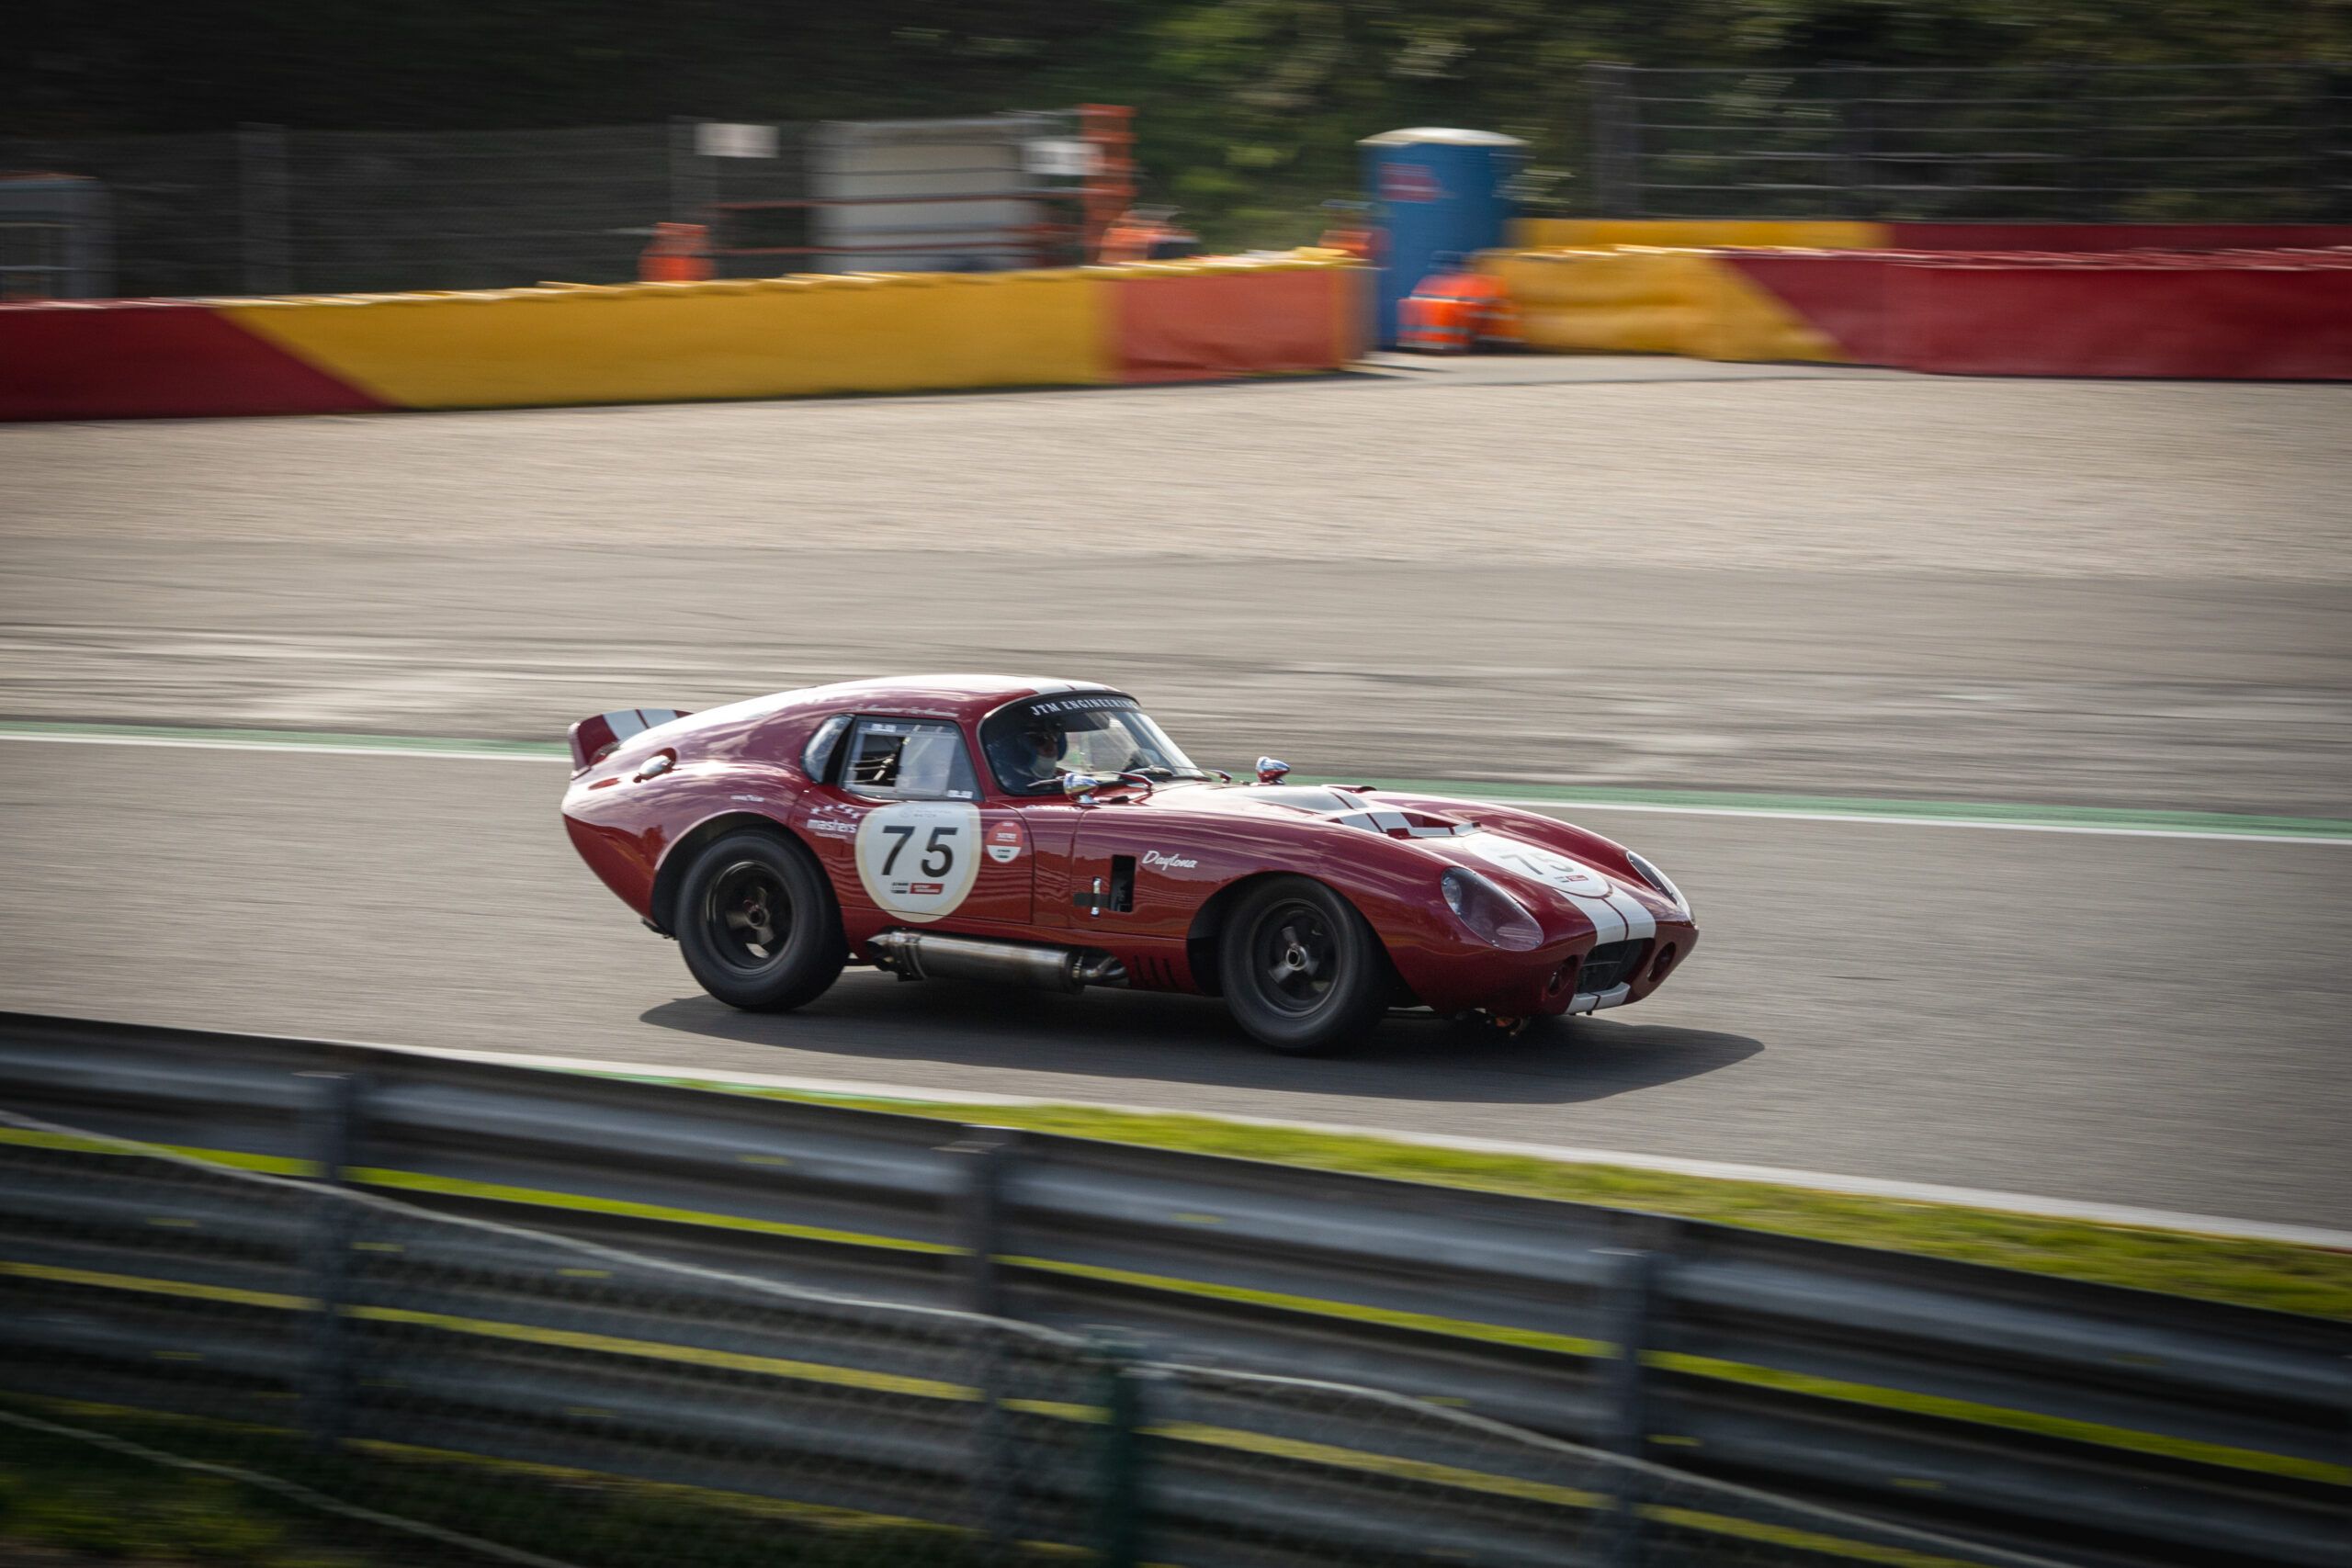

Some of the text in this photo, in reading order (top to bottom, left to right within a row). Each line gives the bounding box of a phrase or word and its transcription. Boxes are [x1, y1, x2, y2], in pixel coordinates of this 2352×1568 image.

[1030, 703, 1061, 716] JTM
[807, 818, 857, 833] masters
[880, 825, 959, 878] 75
[1141, 850, 1199, 872] Daytona
[1498, 852, 1575, 875] 75
